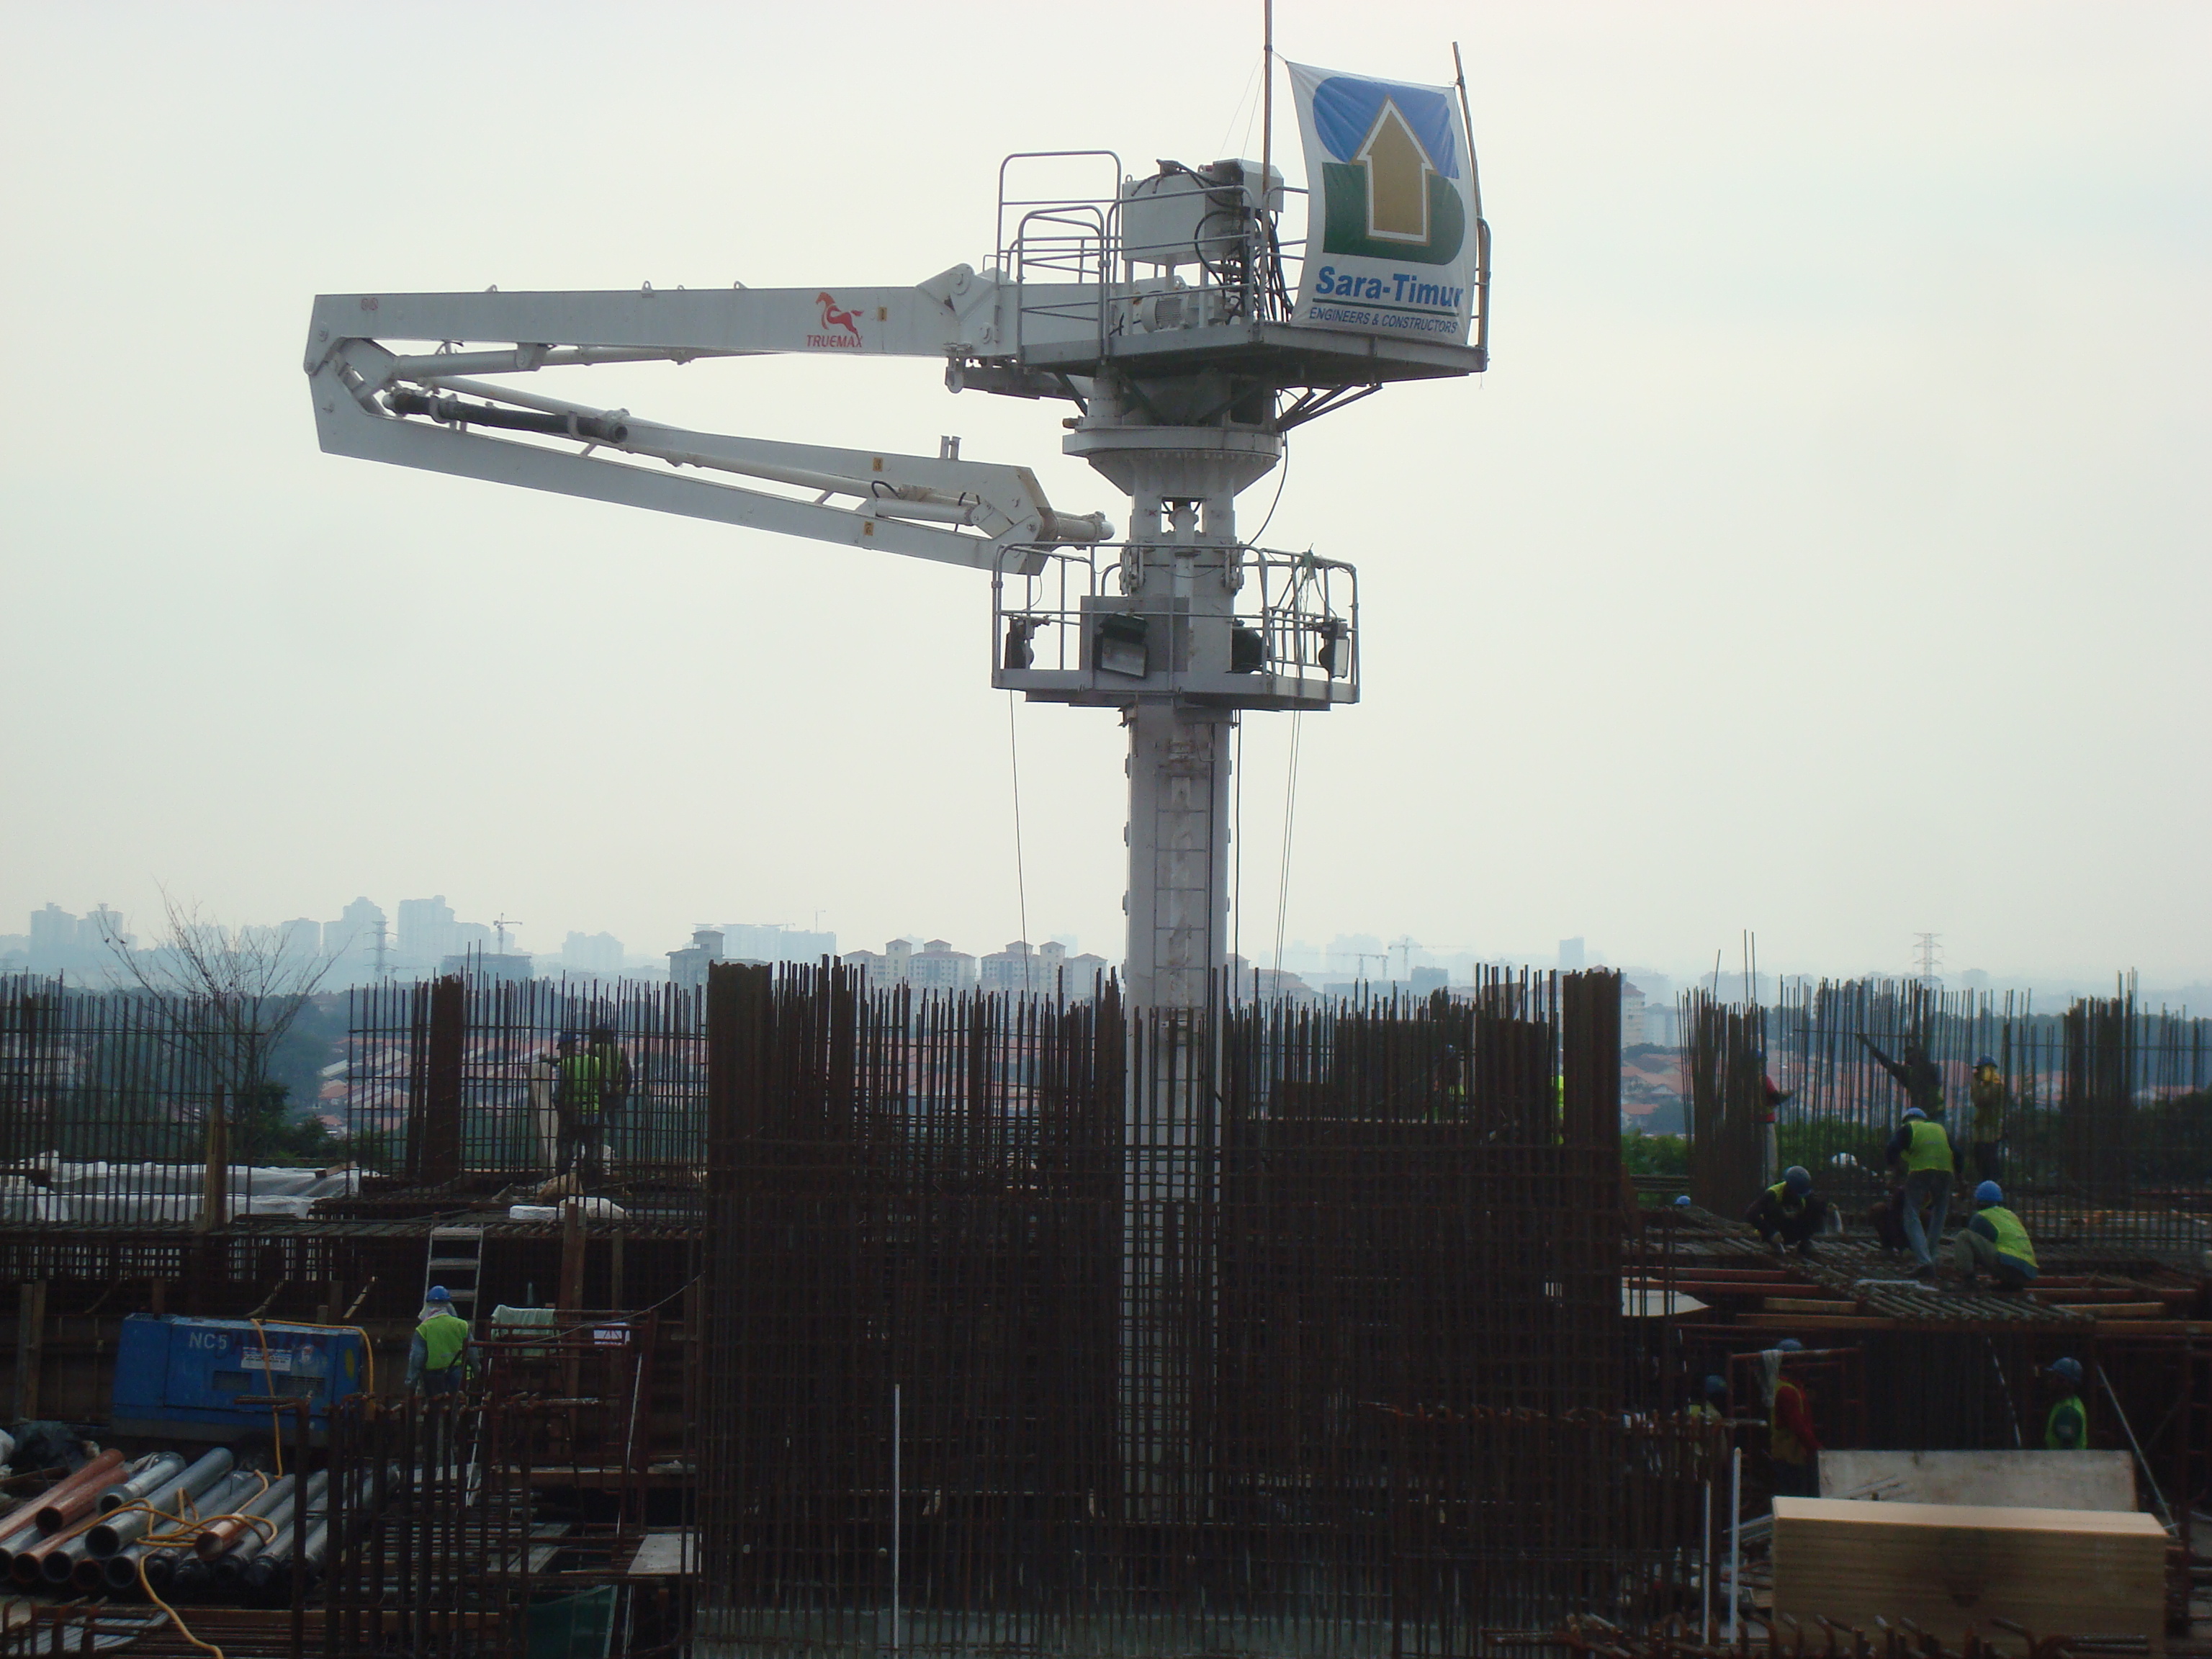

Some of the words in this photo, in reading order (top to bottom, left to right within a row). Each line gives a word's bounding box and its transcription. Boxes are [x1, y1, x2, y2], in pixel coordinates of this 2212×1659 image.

[1316, 266, 1463, 307] Sara-Timur
[1309, 307, 1370, 325] ENGINEERS
[1372, 313, 1379, 325] &
[1381, 314, 1458, 333] CONSTRUCTORS
[806, 334, 863, 348] TRUEMAX
[189, 1332, 227, 1349] NC5
